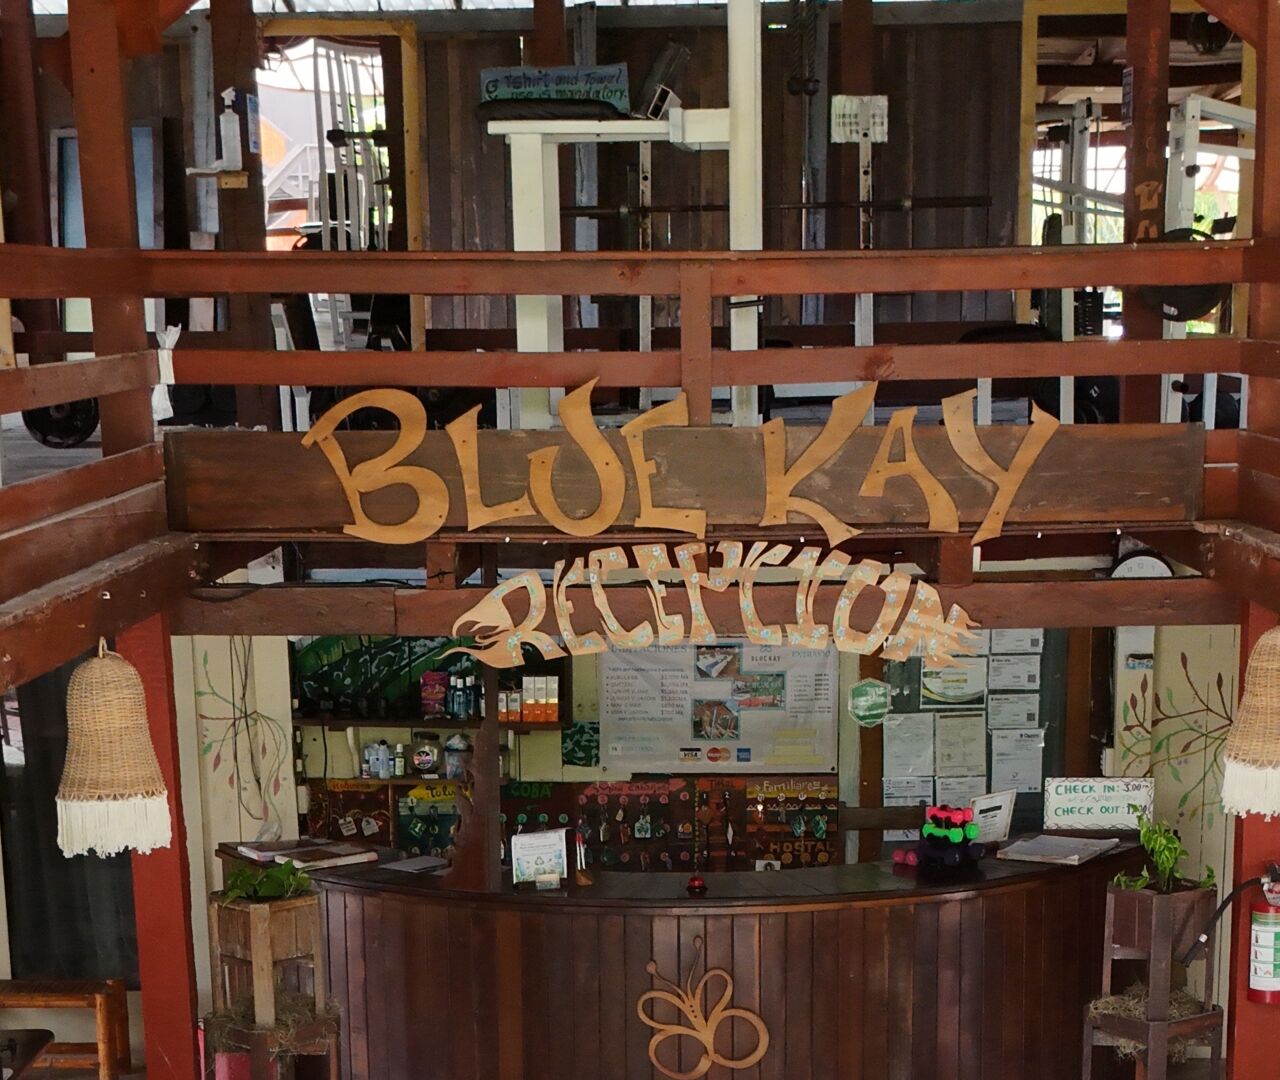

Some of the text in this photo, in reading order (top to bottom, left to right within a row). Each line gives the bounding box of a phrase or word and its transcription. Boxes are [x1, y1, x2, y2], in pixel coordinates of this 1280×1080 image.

[555, 72, 580, 86] and
[583, 67, 622, 85] Towel
[538, 87, 551, 99] is
[301, 377, 1060, 548] BLUE KAY
[763, 779, 821, 792] Familiares
[1054, 784, 1096, 796] CHECK
[1054, 806, 1095, 817] CHECK
[769, 840, 830, 854] HOSTAL
